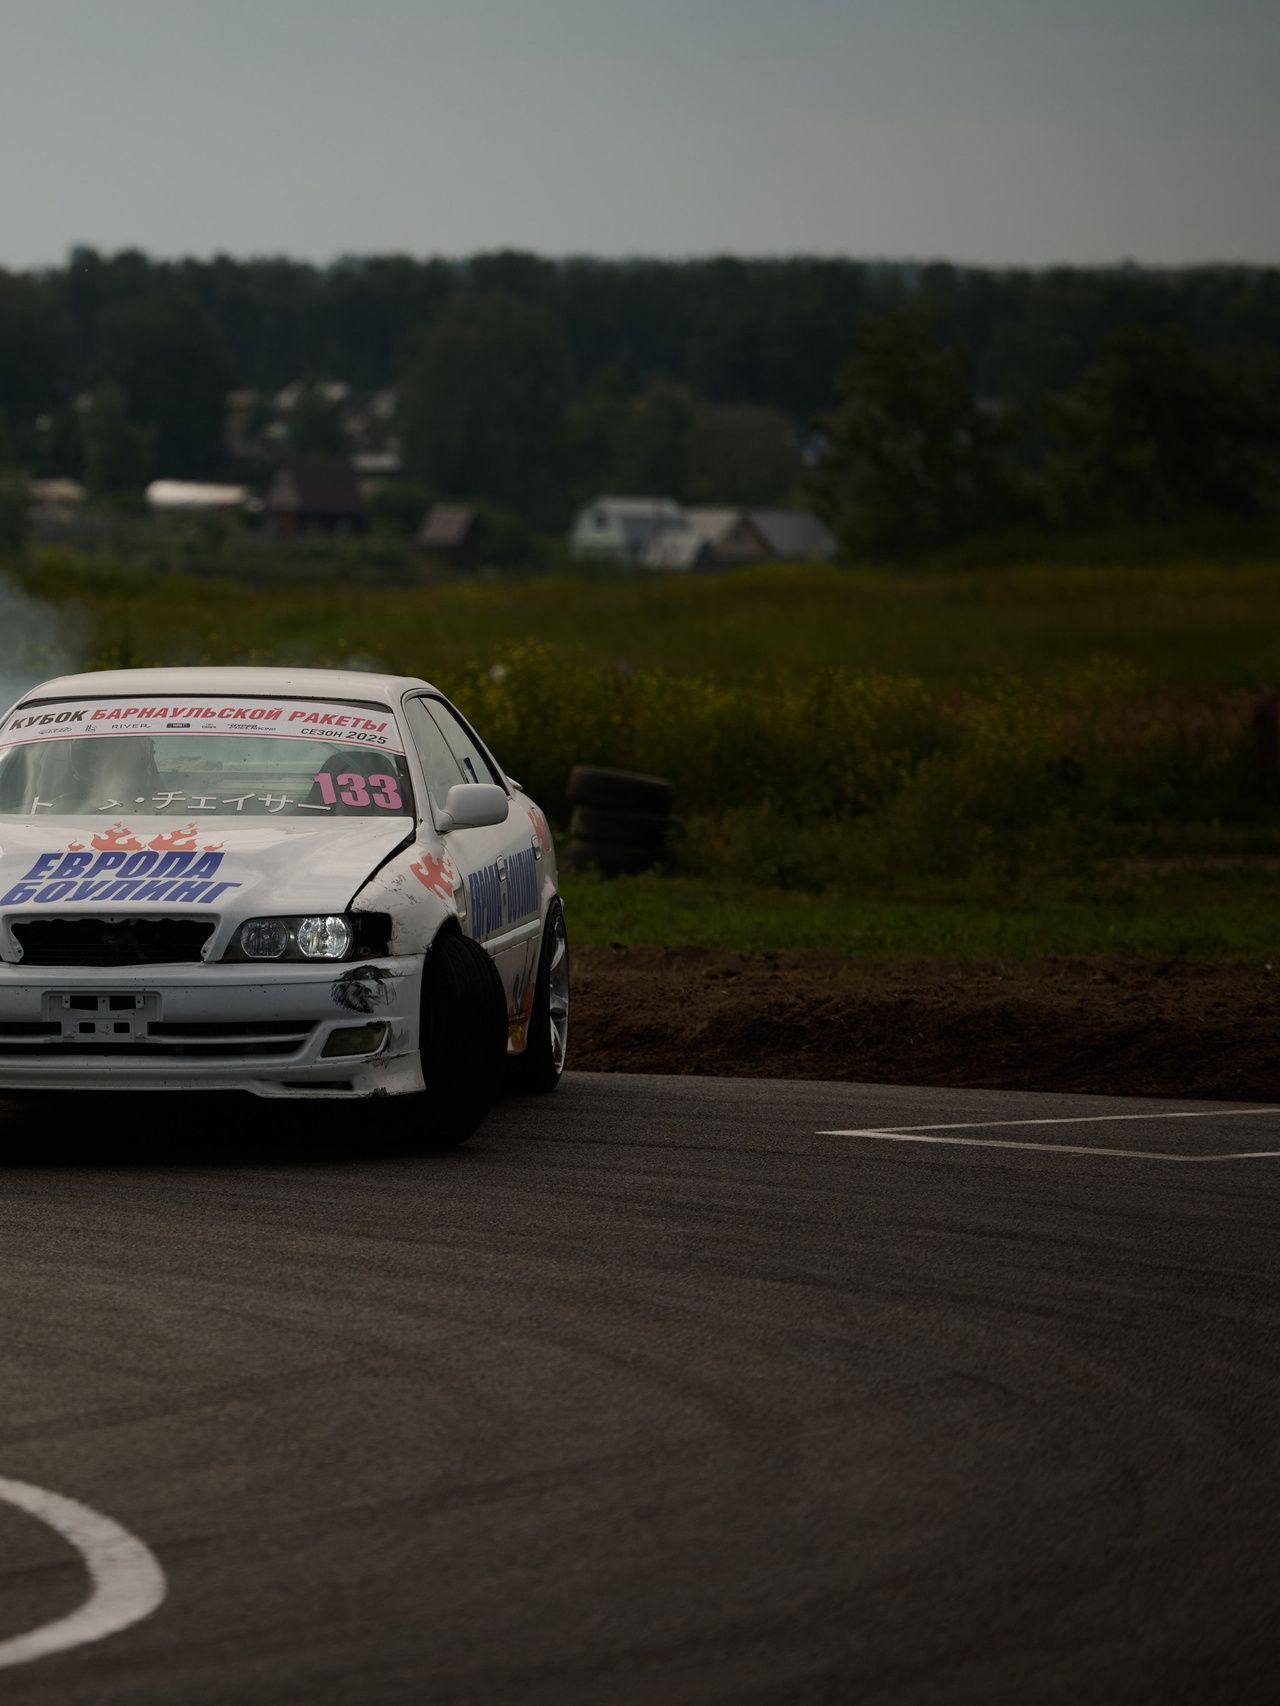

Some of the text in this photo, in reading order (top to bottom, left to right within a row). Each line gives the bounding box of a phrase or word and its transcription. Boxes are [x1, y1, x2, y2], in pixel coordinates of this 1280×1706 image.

[9, 706, 388, 733] КУБОК БАРНАУЛЬСКОЙ РАКЕТЫ
[300, 727, 389, 745] СЕЗОН 2025
[313, 772, 403, 810] 133
[20, 851, 225, 880] ЕВРОПА
